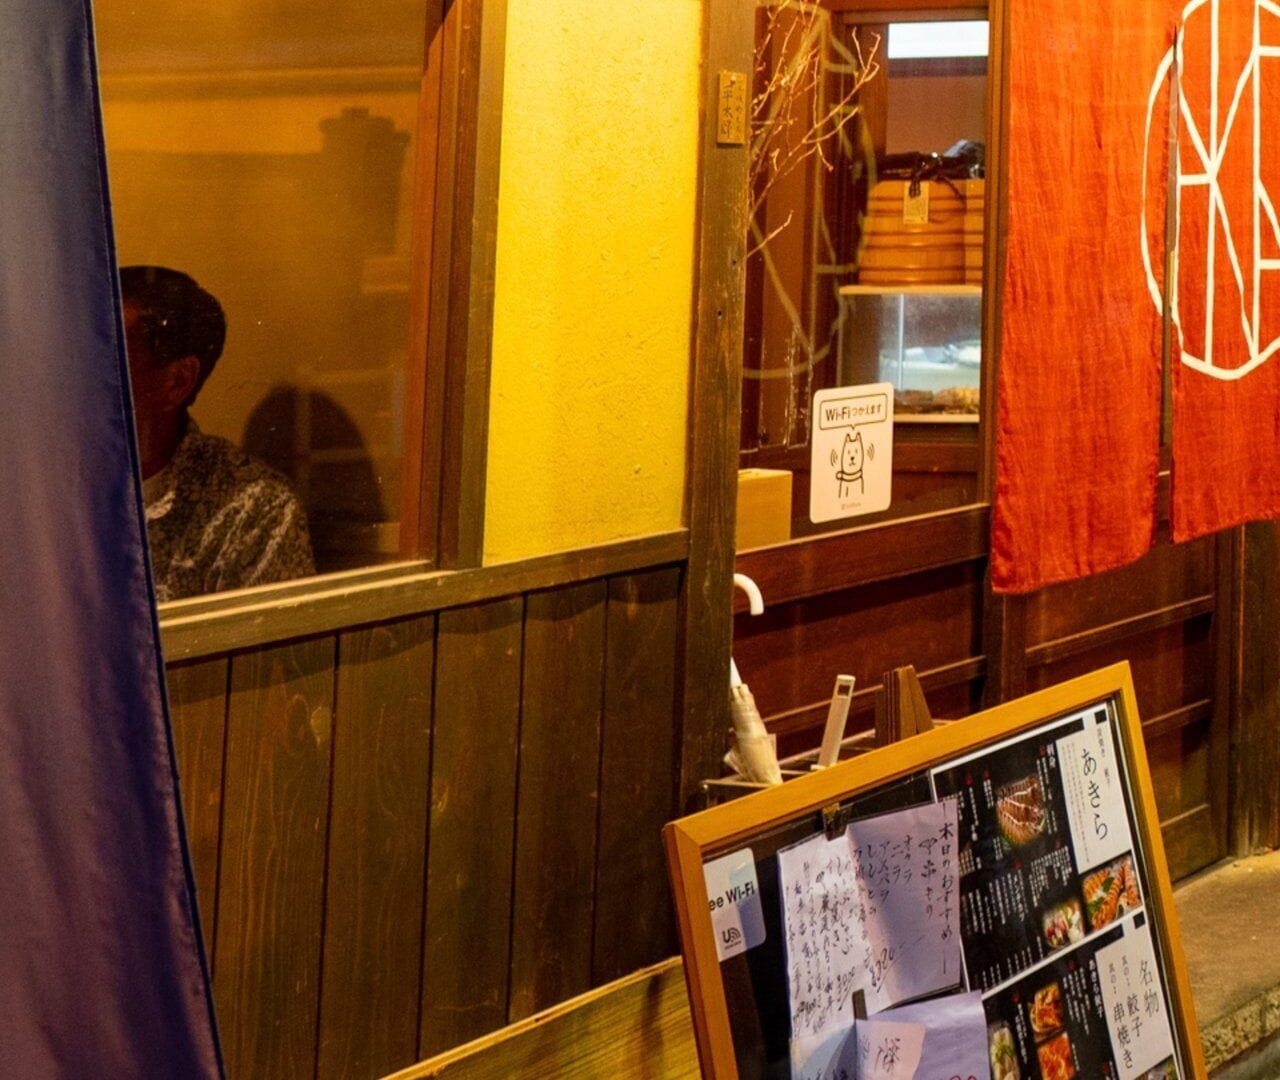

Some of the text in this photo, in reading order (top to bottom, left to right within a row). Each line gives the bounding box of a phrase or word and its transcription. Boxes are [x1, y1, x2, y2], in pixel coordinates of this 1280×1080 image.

[1082, 748, 1109, 841] あきら
[708, 881, 755, 911] ee Wi-Fi
[1126, 993, 1144, 1038] 餃子
[1138, 959, 1161, 1018] 名物
[1113, 1000, 1134, 1070] 串焼き
